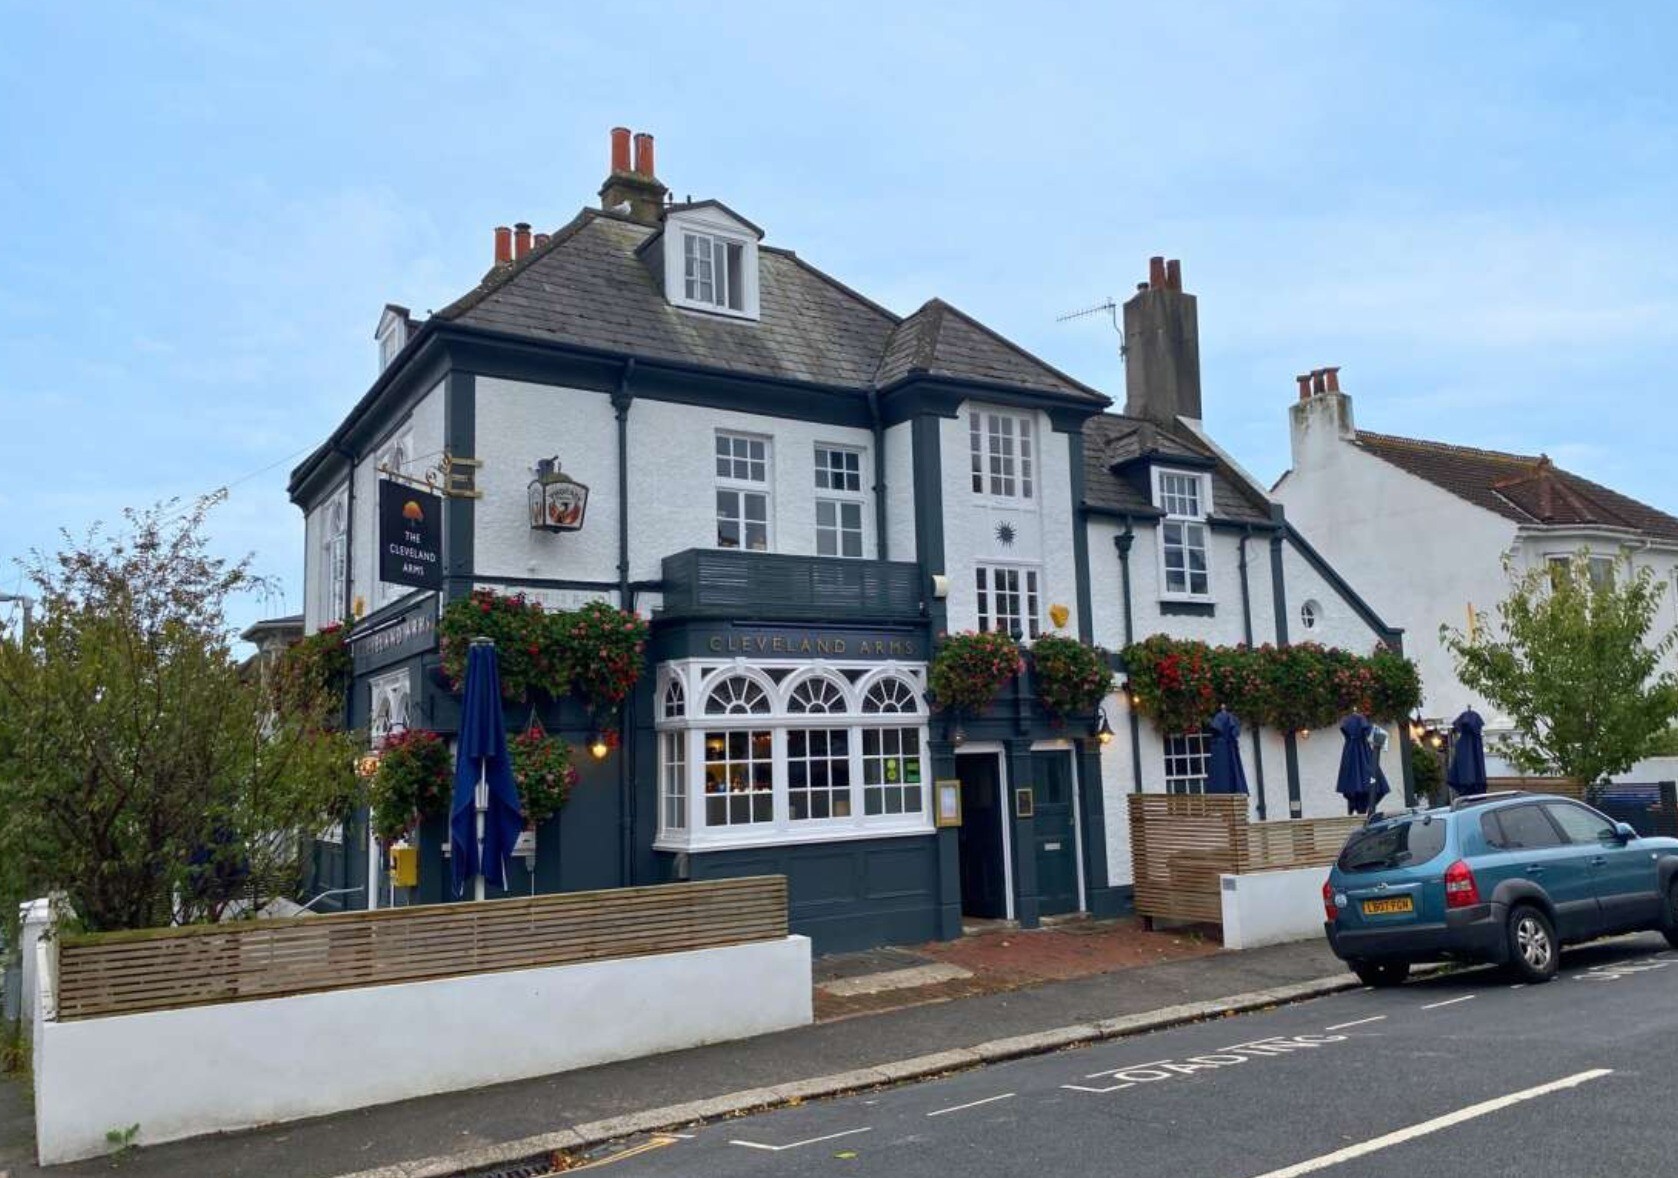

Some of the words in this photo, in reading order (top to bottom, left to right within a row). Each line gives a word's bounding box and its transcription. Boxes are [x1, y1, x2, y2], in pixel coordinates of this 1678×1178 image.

[404, 530, 421, 544] THE
[389, 543, 436, 562] CLEVELAND
[403, 561, 425, 576] ARMS
[709, 634, 847, 653] CLEVELAND
[859, 639, 915, 655] ARMS
[1060, 1033, 1348, 1093] LOADING
